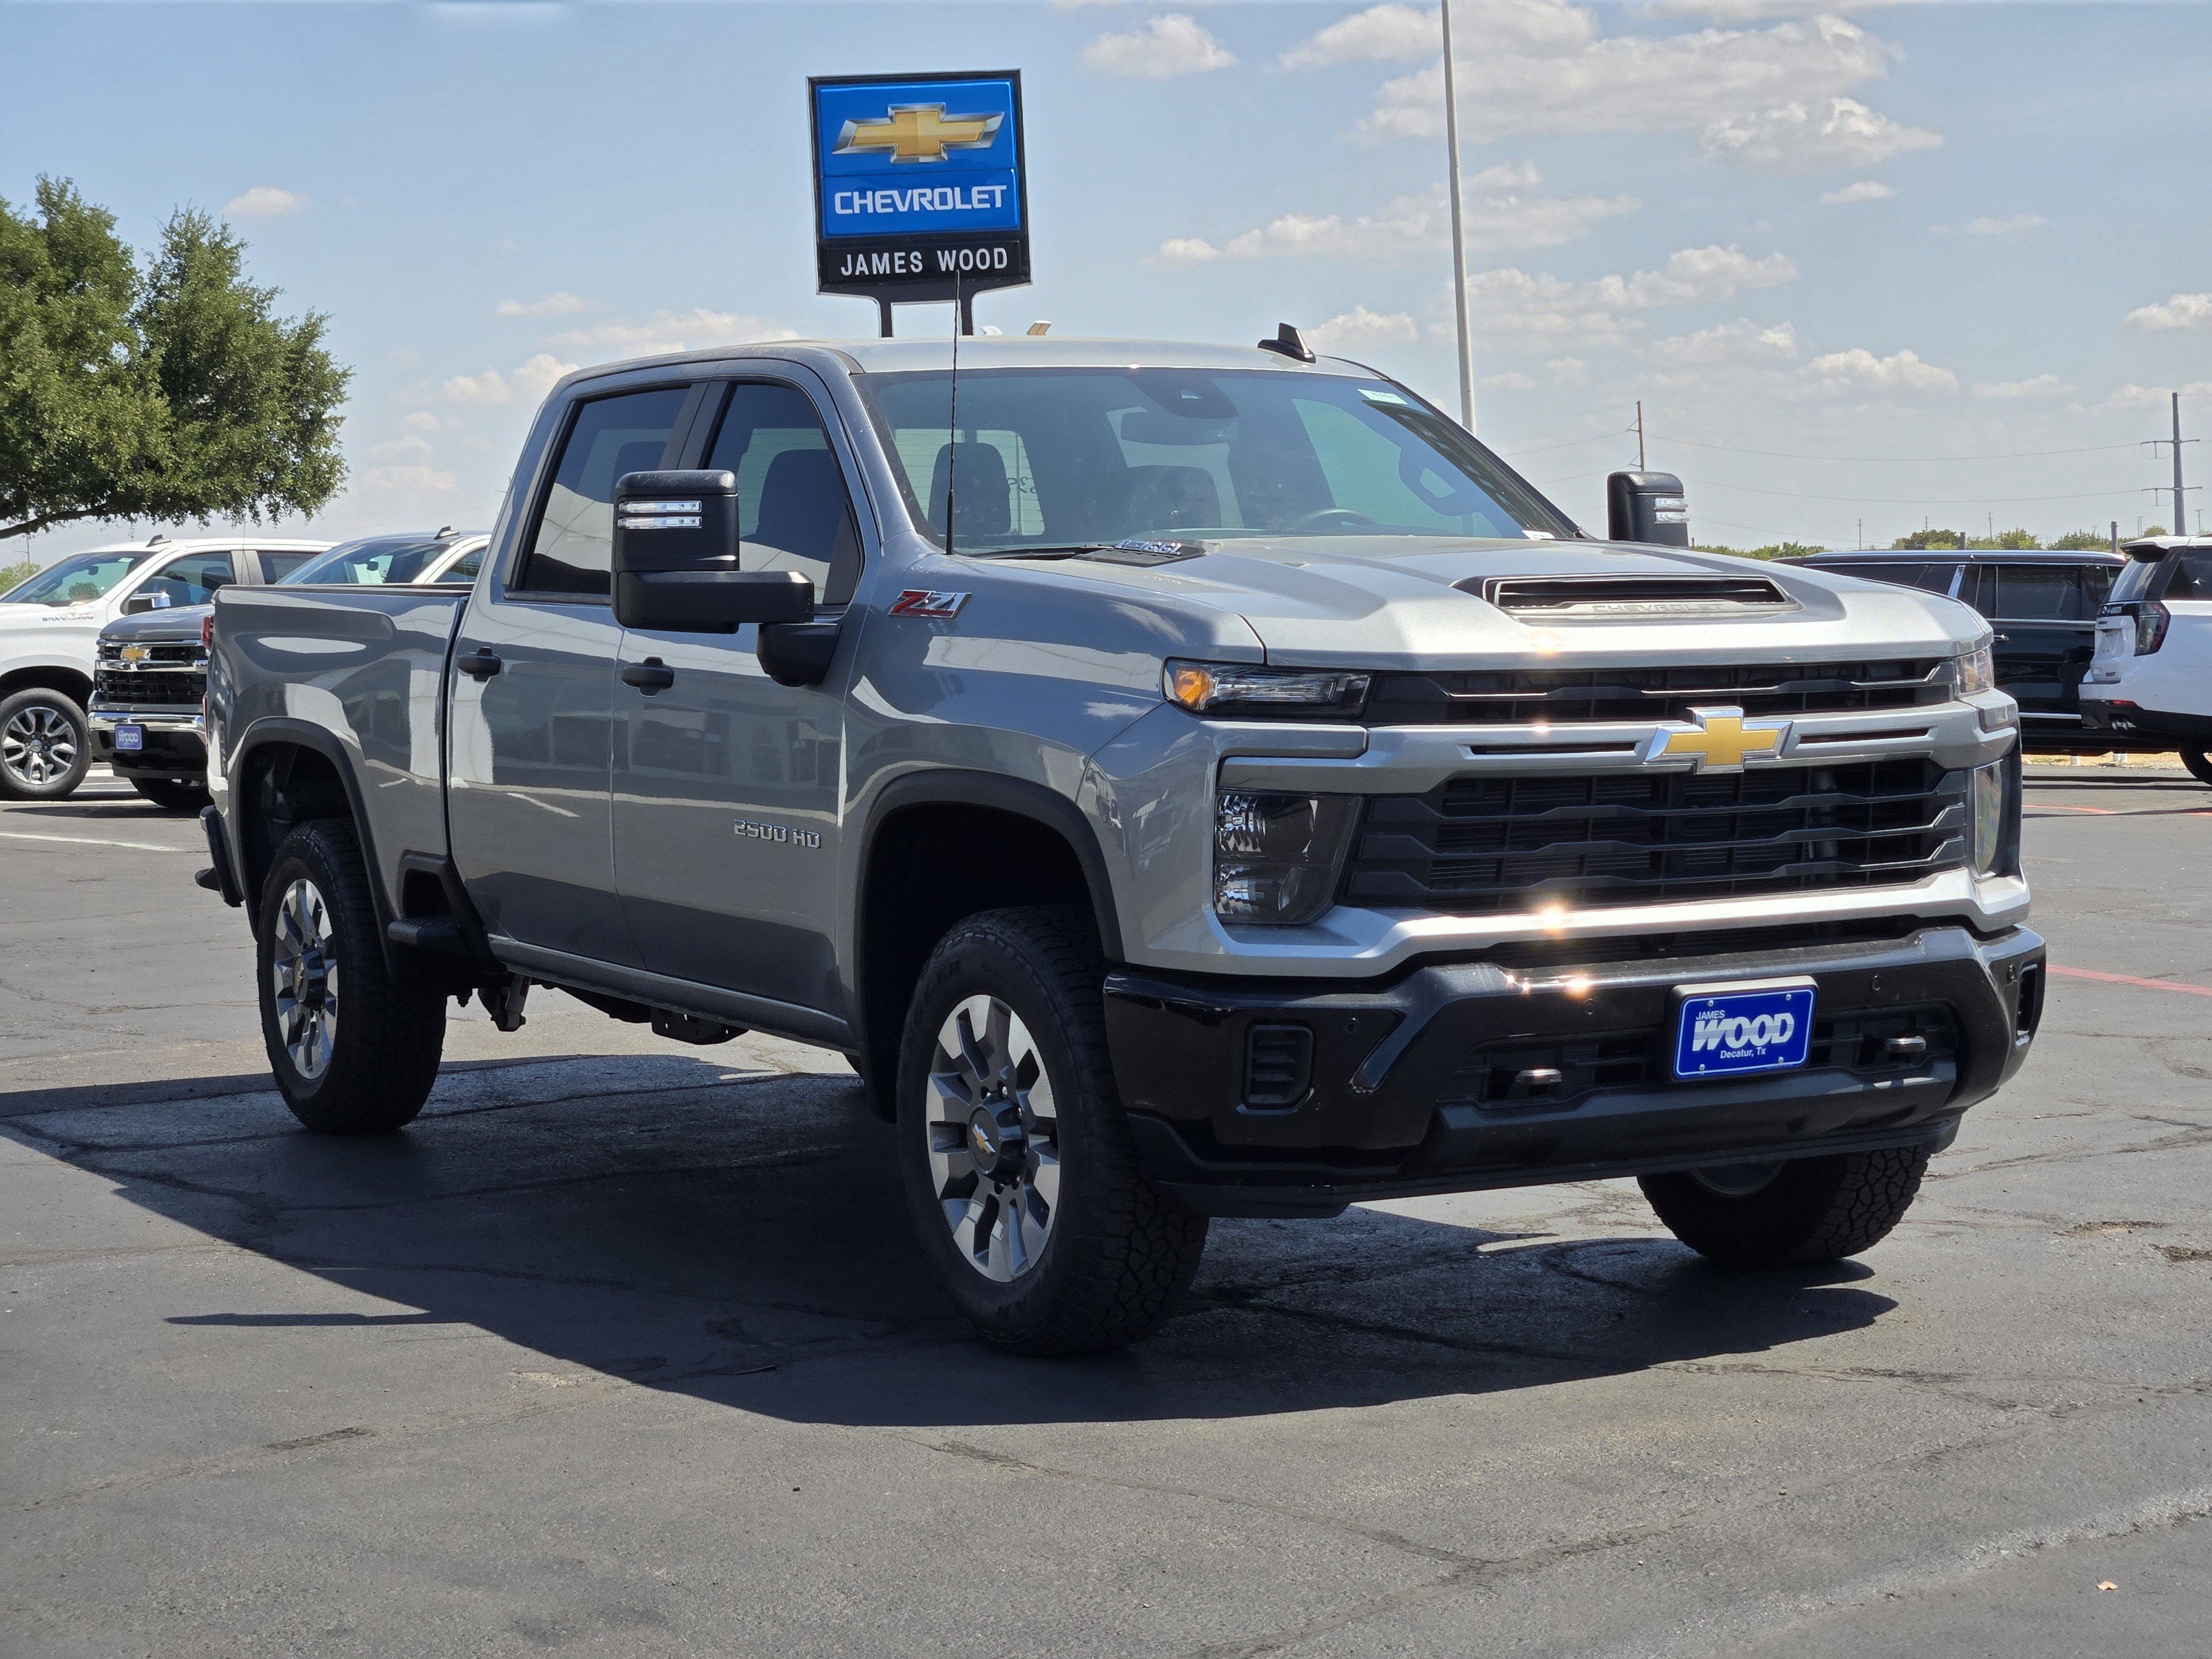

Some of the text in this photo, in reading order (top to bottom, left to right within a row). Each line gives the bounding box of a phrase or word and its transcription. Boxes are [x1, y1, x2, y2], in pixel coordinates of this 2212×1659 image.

[834, 185, 1006, 214] CHEVROLET
[841, 248, 1008, 275] JAMES WOOD
[887, 589, 972, 618] Z71
[1592, 604, 1723, 613] CHEVROLET
[118, 733, 138, 742] WOOD
[734, 819, 821, 849] 2500 HD
[1695, 1010, 1725, 1020] JAMES
[1692, 1013, 1794, 1052] WOOD
[1720, 1047, 1766, 1059] Decatur, Tx
